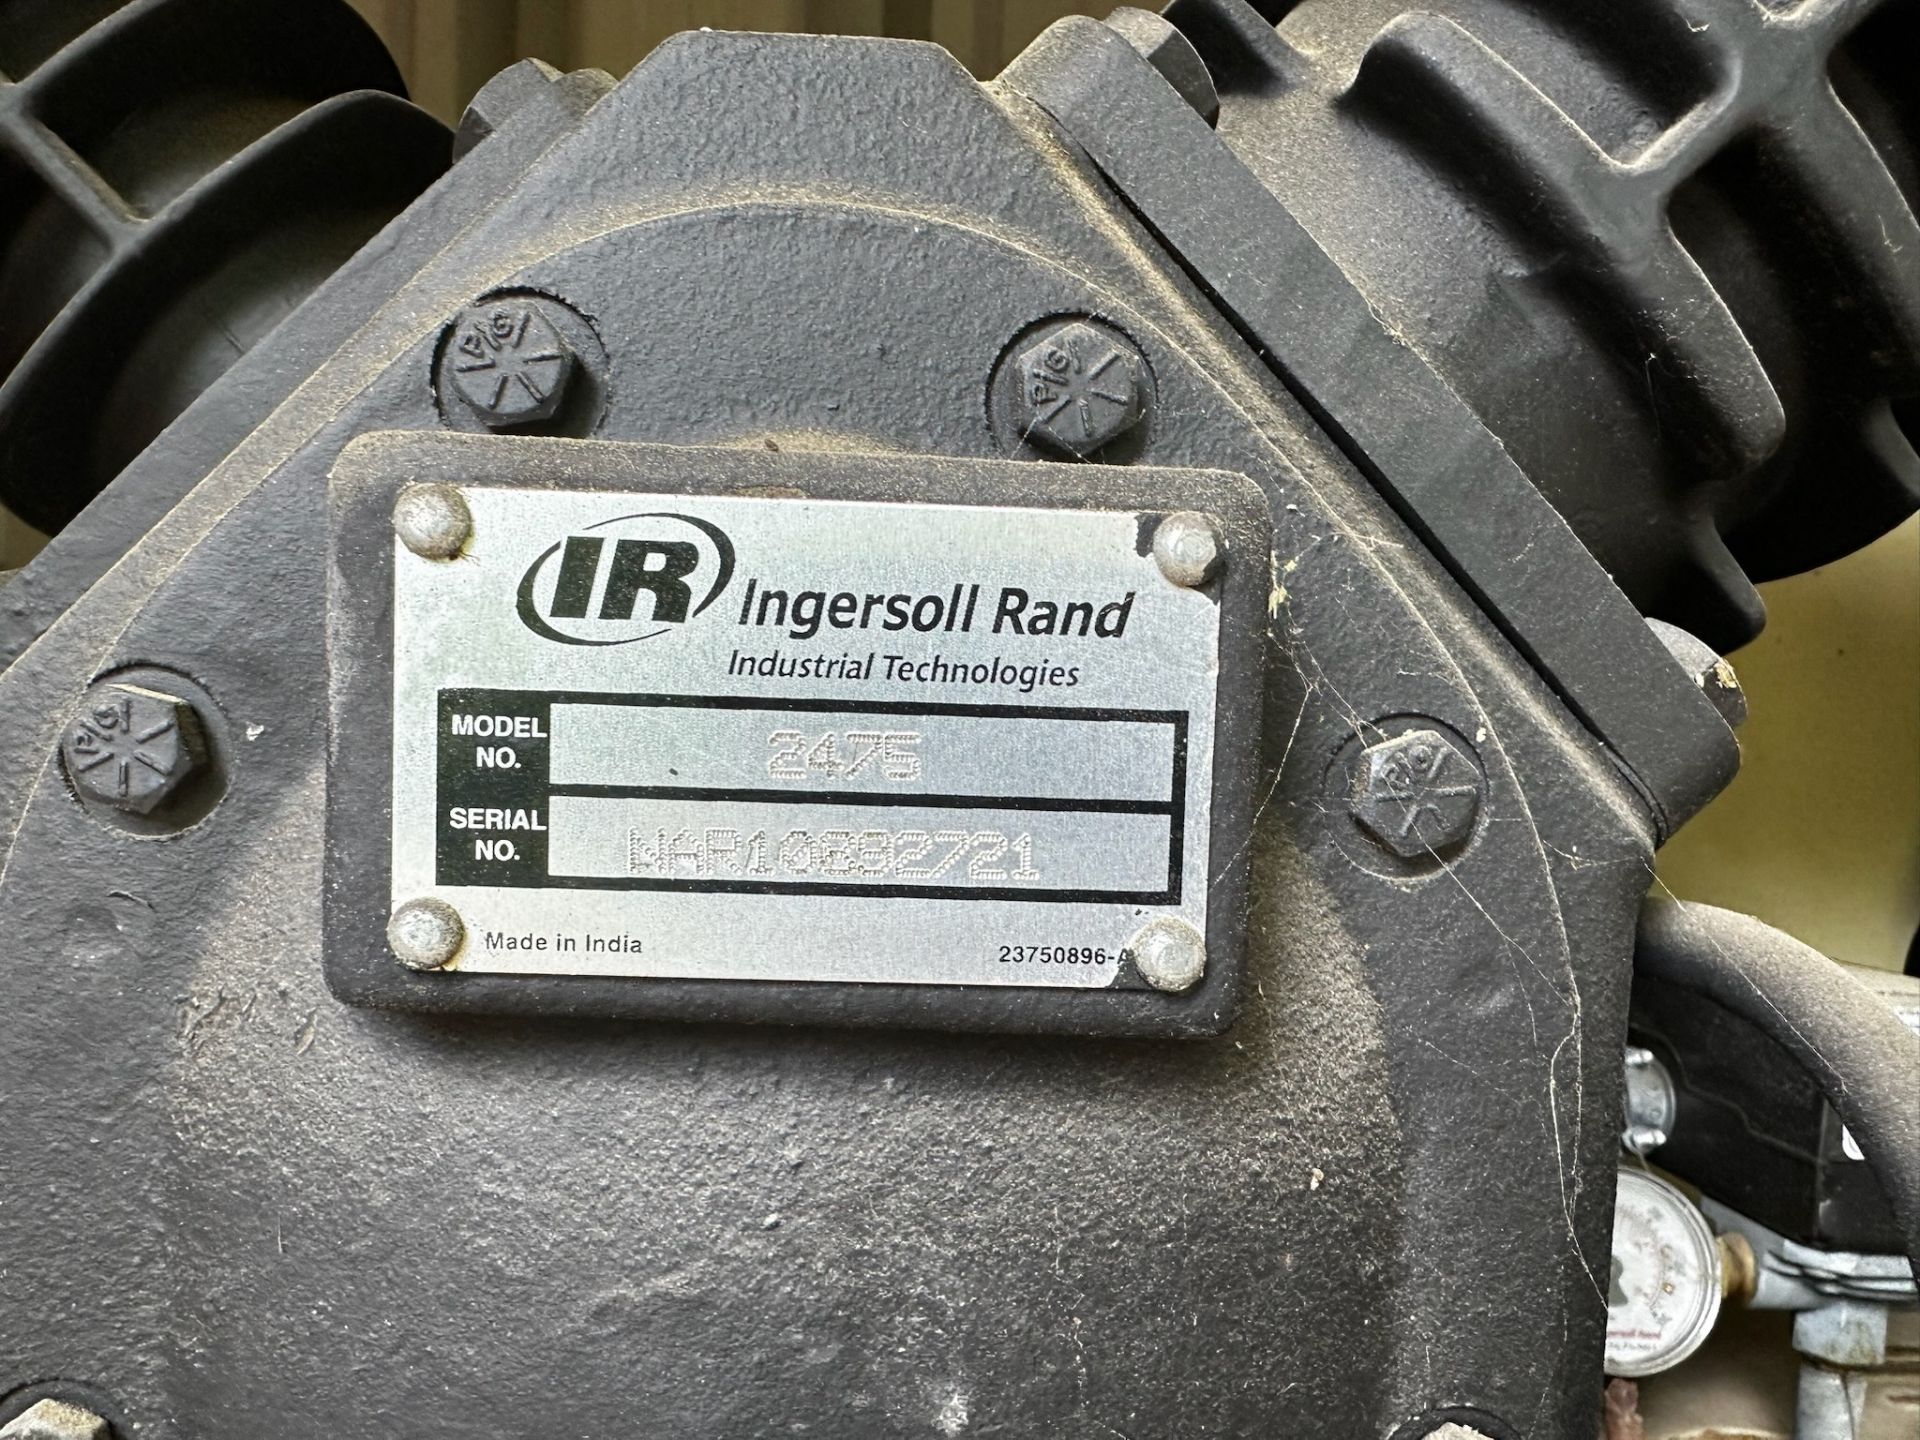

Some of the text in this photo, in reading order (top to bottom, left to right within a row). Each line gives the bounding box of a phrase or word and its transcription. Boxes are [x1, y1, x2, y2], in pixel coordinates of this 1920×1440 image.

[549, 535, 700, 624] IR
[738, 578, 1136, 640] Ingersoll Rand
[727, 649, 1080, 693] Industrial Technologies
[451, 713, 548, 739] MODEL
[476, 746, 522, 769] NO.
[768, 730, 922, 780] 2475
[450, 807, 548, 831] SERIAL
[475, 839, 521, 862] NO.
[486, 931, 643, 954] Made in India
